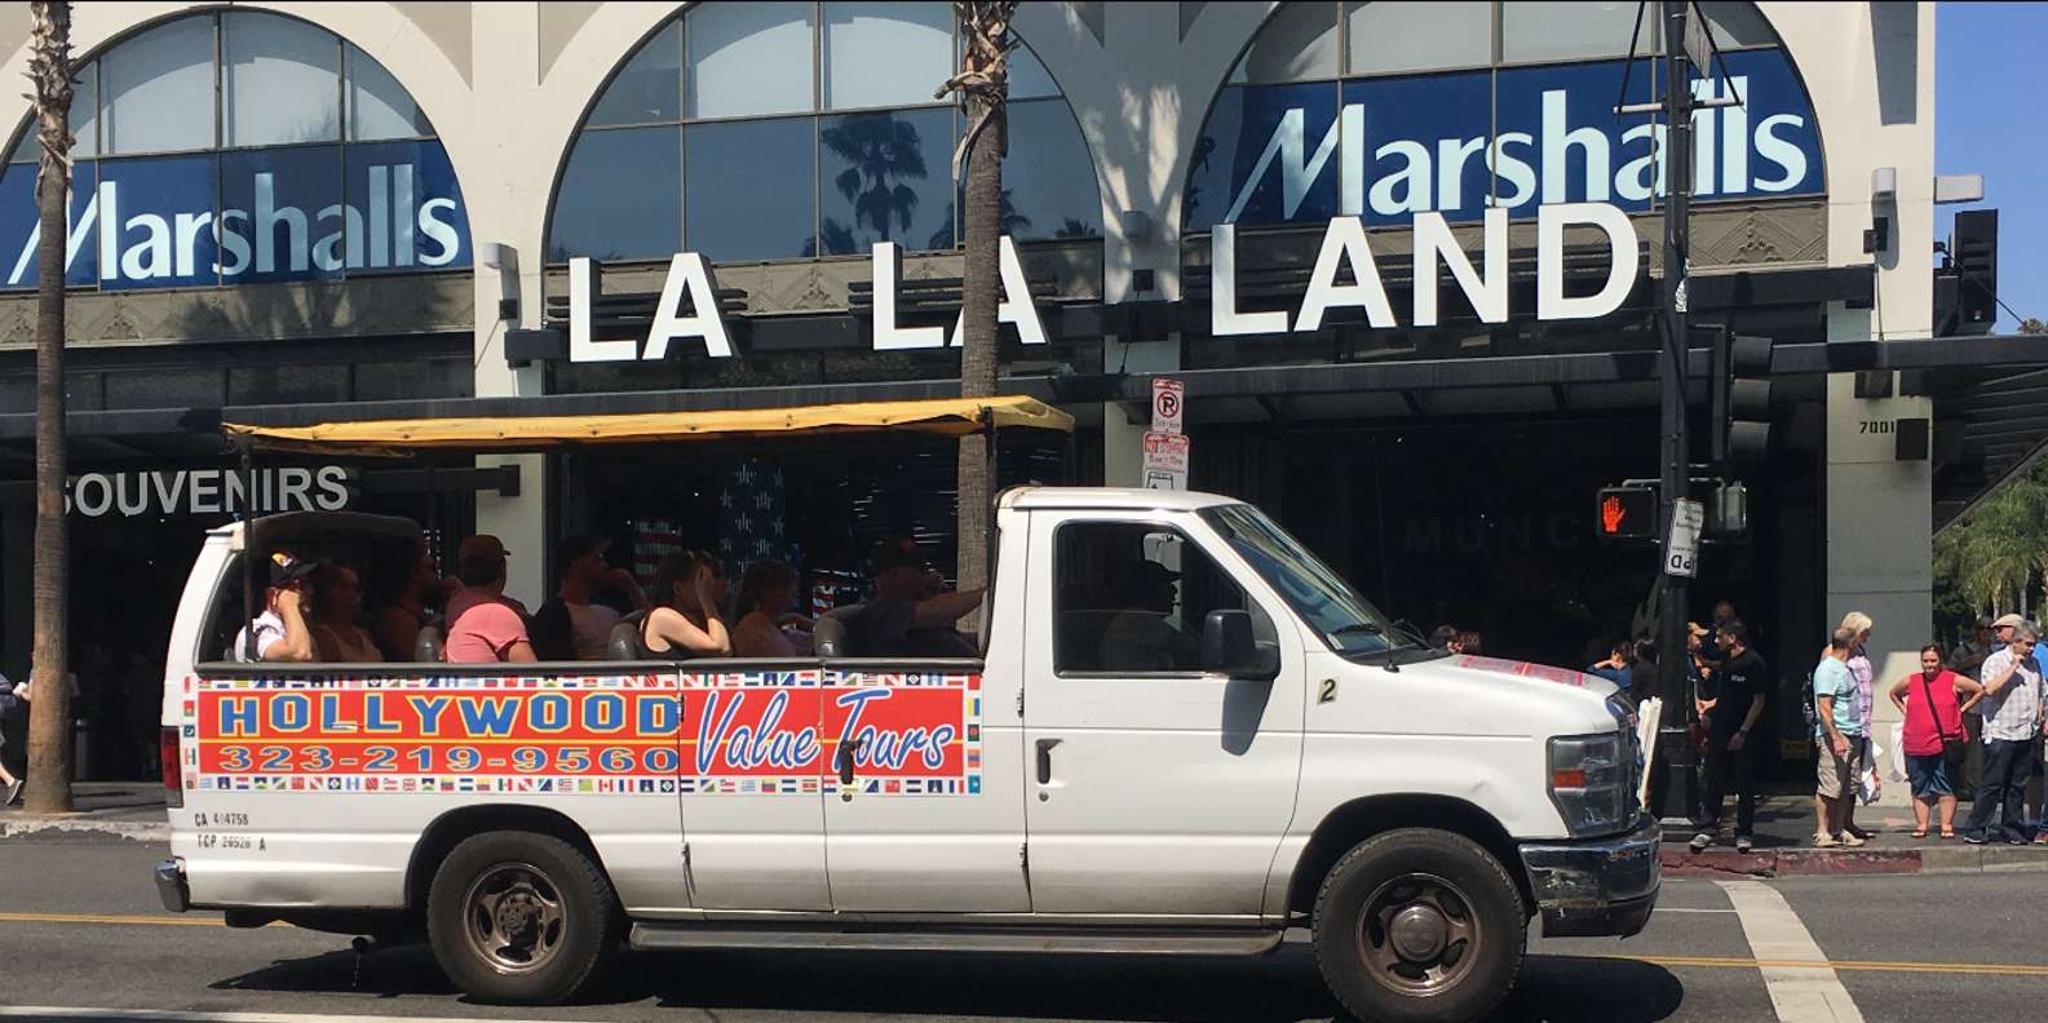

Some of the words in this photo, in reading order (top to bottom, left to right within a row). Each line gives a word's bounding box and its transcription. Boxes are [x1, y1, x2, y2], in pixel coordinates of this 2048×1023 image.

[1224, 76, 1808, 222] Marshalls
[8, 164, 459, 284] Marshalls
[569, 252, 733, 362] LA
[1211, 202, 1640, 336] LAND
[1859, 421, 1895, 434] 7001
[218, 692, 680, 738] HOLLYWOOD
[1320, 678, 1336, 703] 2
[218, 745, 680, 773] 323-219-9560
[696, 690, 822, 775] Value
[831, 688, 954, 772] Tours
